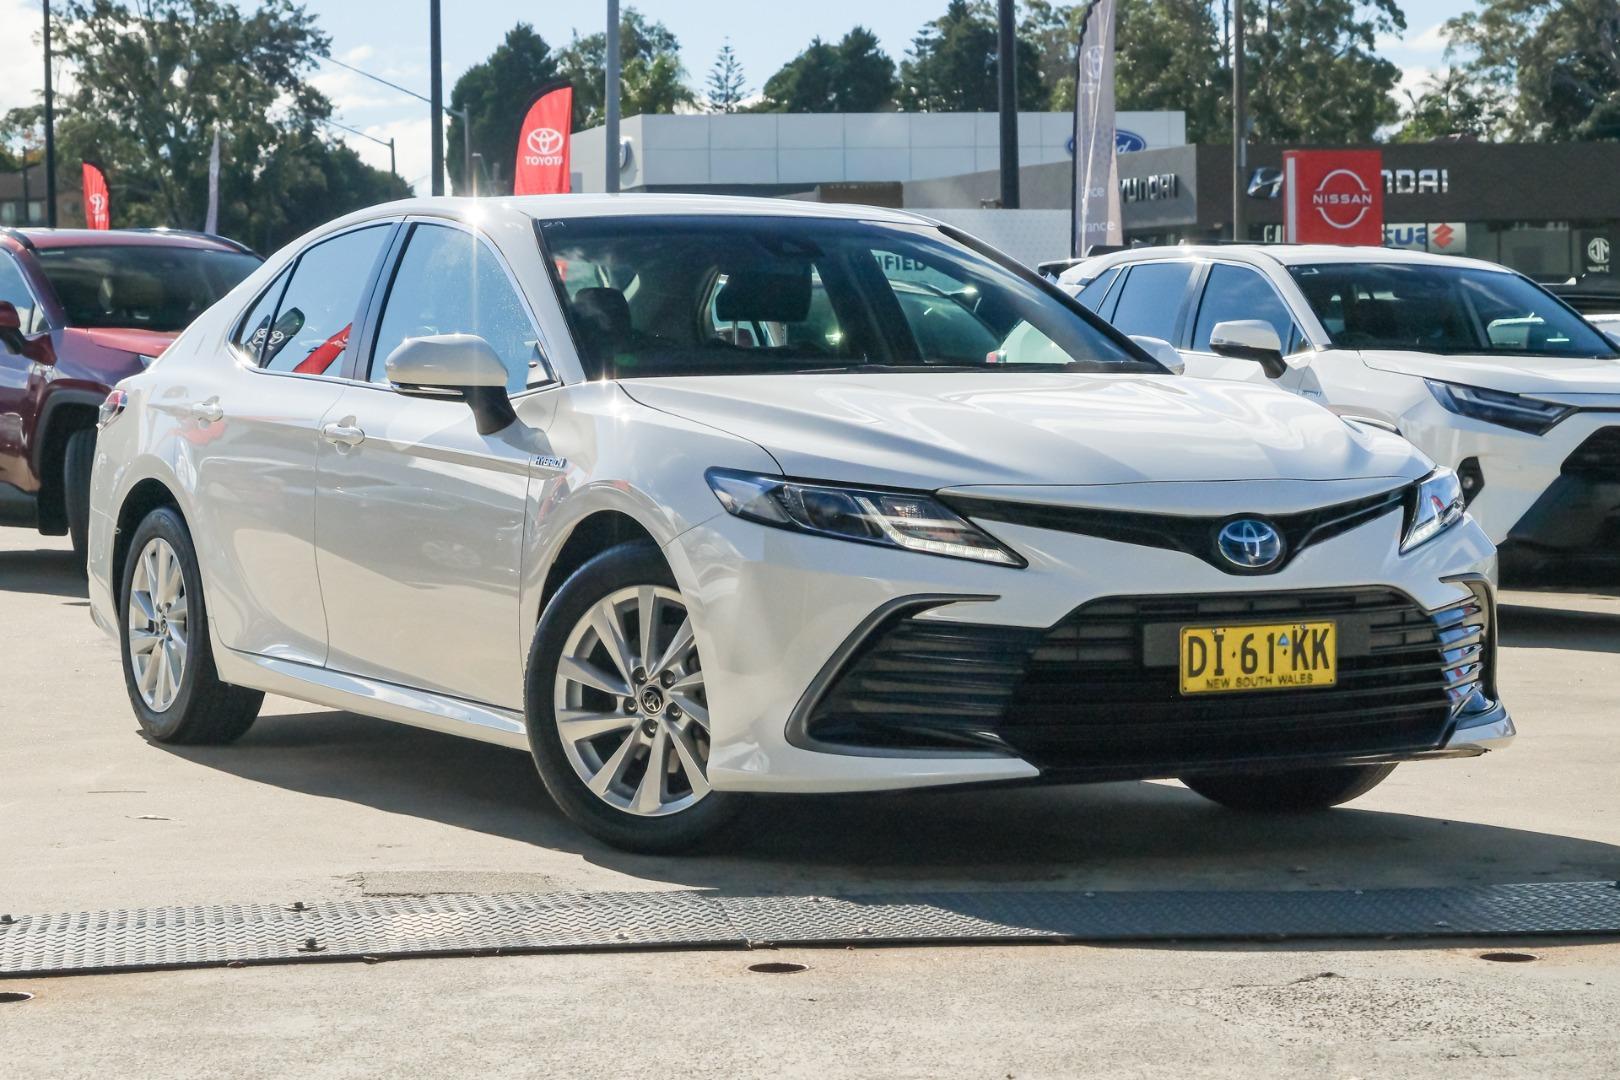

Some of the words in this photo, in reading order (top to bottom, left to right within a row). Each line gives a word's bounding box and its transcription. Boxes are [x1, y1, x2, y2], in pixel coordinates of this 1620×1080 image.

[1120, 173, 1176, 201] YUNDAI
[1381, 169, 1448, 193] NDAI
[1312, 194, 1372, 204] NISSAN
[1206, 677, 1231, 689] NEW
[1236, 675, 1272, 688] SOUTH
[1278, 673, 1314, 685] WALES
